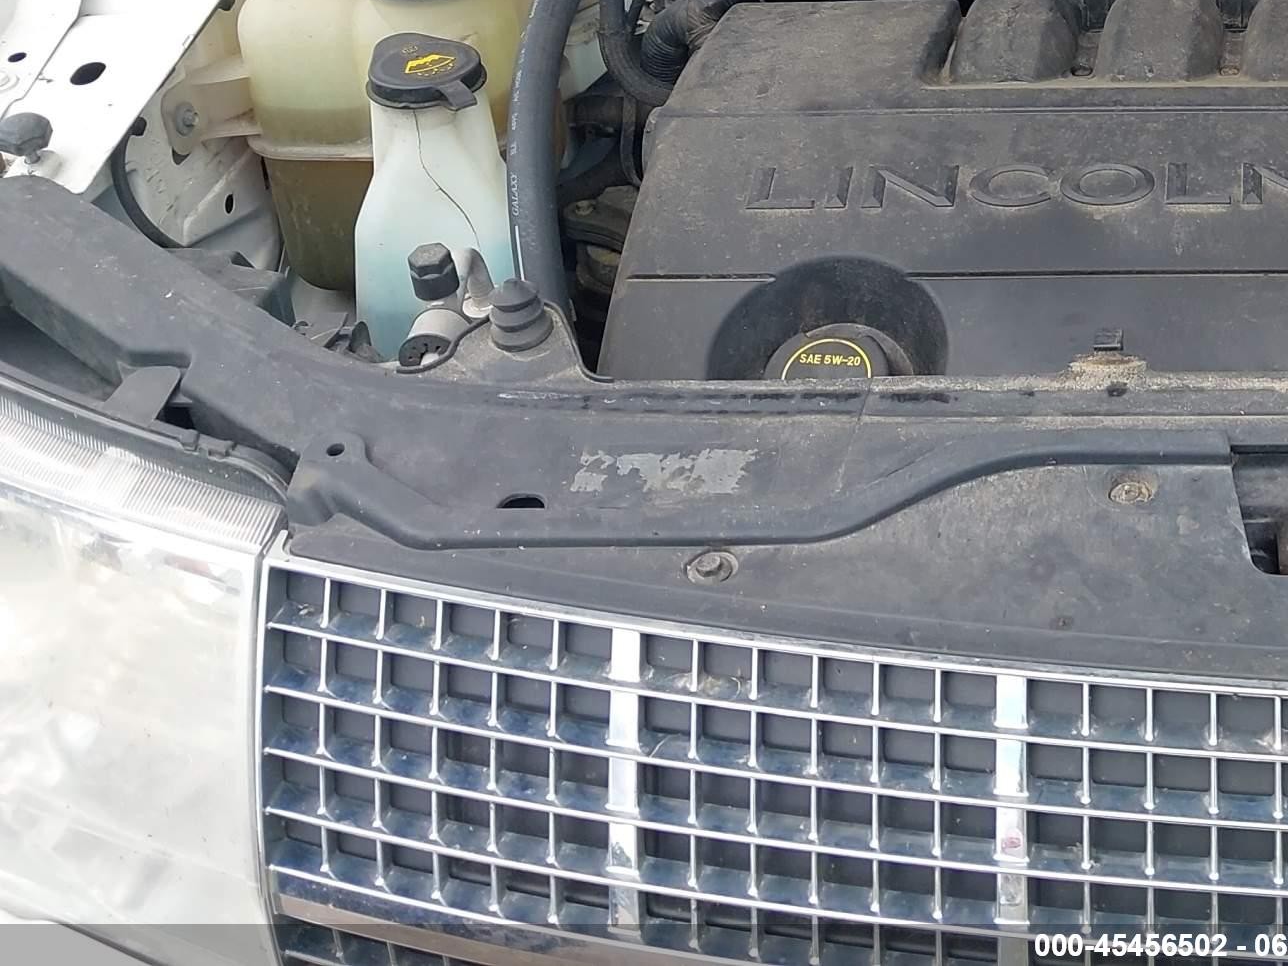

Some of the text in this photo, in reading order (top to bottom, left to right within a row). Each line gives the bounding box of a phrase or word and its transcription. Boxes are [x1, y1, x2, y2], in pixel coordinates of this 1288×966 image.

[510, 172, 520, 216] GALAXY
[799, 353, 861, 366] SAE 5W-20
